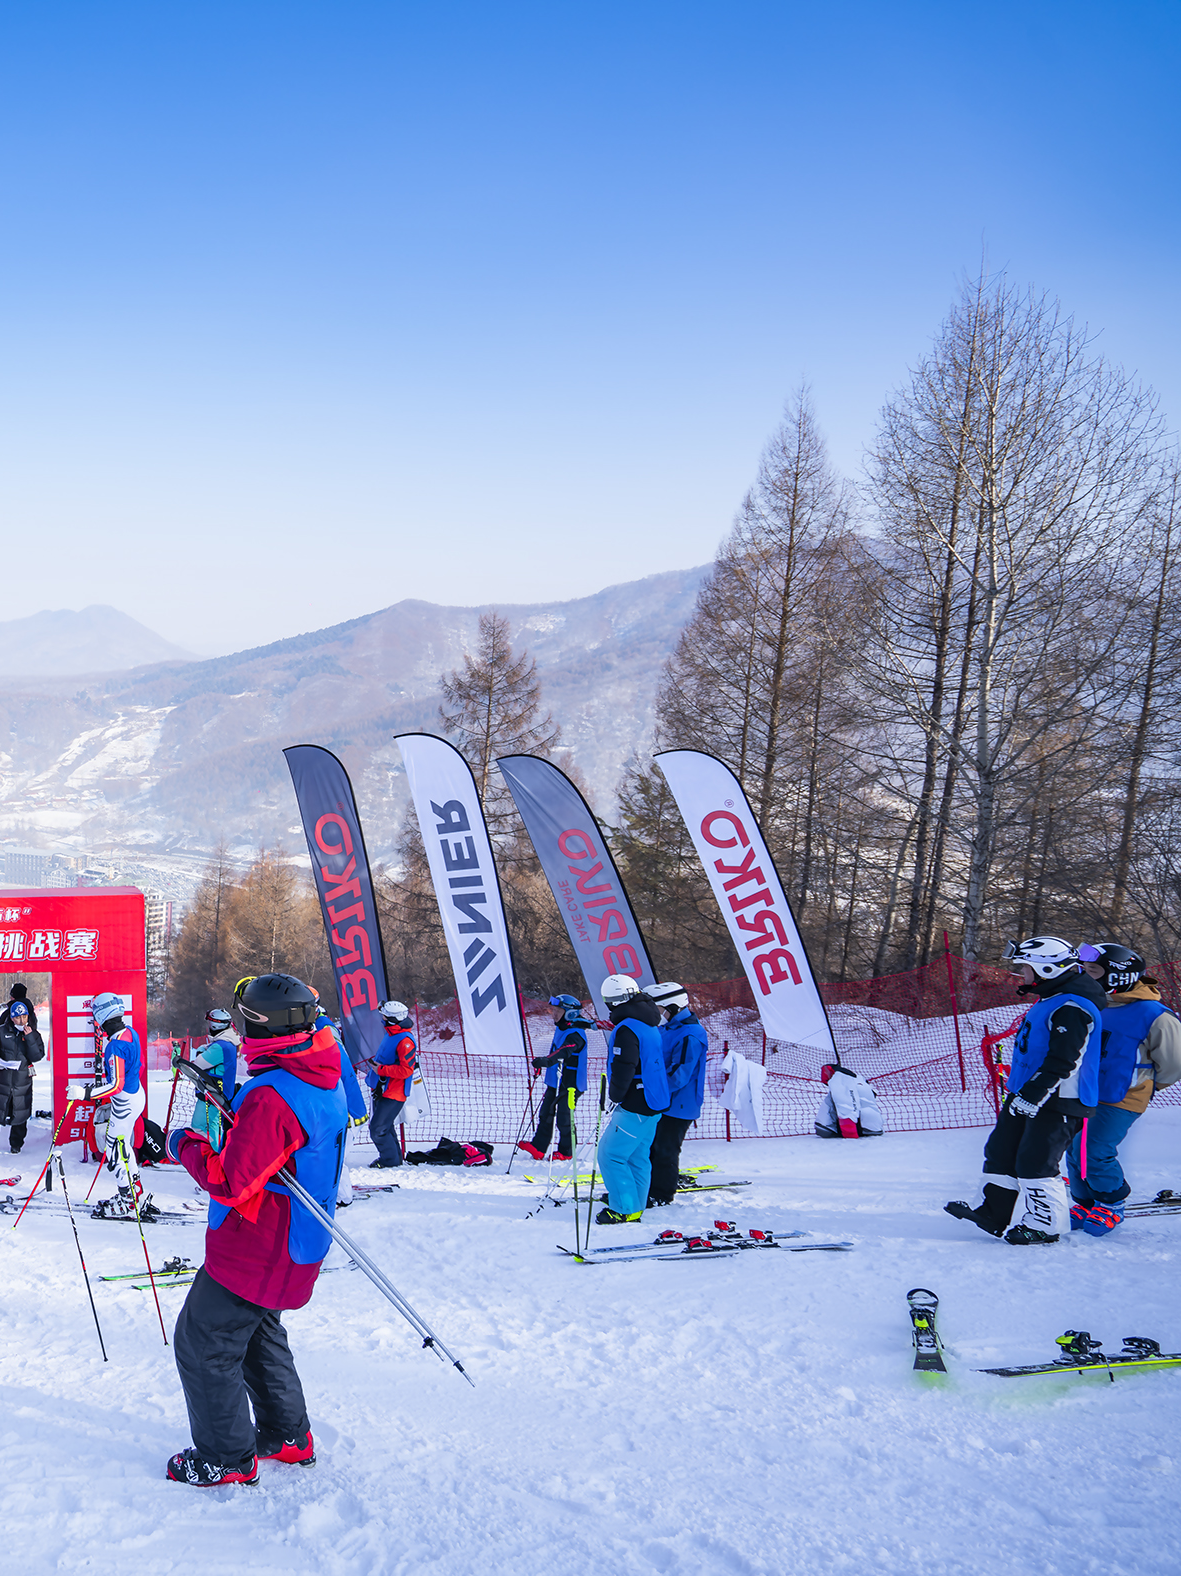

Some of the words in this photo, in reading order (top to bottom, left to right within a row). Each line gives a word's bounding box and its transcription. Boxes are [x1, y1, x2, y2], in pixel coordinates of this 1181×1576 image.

[1107, 971, 1140, 987] CHN
[74, 1105, 95, 1123] 起
[1026, 1186, 1052, 1226] HALTI
